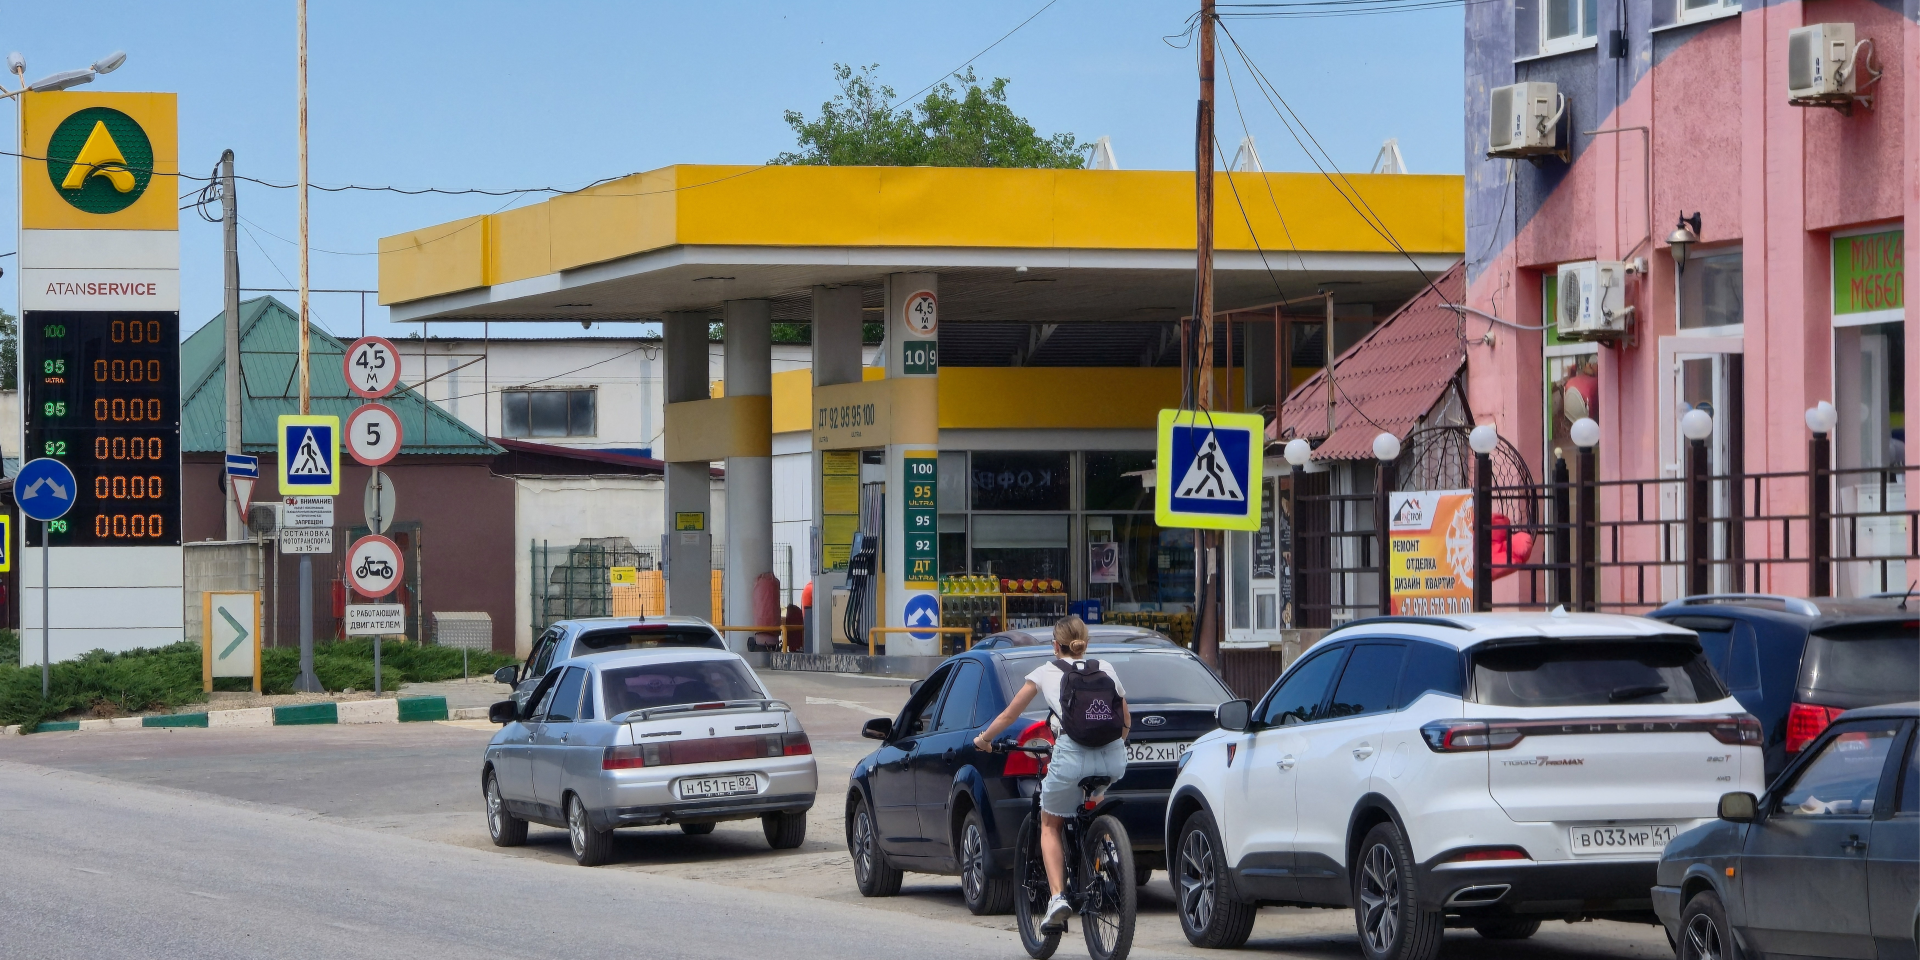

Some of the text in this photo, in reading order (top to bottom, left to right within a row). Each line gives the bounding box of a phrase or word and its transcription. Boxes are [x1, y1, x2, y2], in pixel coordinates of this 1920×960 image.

[46, 283, 157, 296] ATANSERVICE
[915, 302, 934, 316] 4,5
[44, 325, 66, 338] 100
[356, 350, 386, 372] 4,5
[905, 349, 936, 366] 10 9
[44, 360, 65, 373] 95
[366, 373, 378, 384] М
[44, 403, 65, 416] 95
[819, 403, 875, 430] ДТ 92 95 95 100
[366, 422, 381, 446] 5
[45, 441, 66, 455] 92
[911, 463, 933, 474] 100
[914, 485, 931, 498] 95
[47, 521, 67, 533] PG
[915, 516, 930, 526] 95
[915, 540, 930, 551] 92
[1392, 540, 1420, 552] РЕМОНТ
[913, 560, 931, 573] ДТ
[1406, 558, 1437, 572] ОТДЕЛКА
[1394, 575, 1456, 592] ДИЗАЙН КВАРТИР
[357, 609, 400, 618] РАБОТАЮЩИМ
[350, 621, 401, 630] ДВИГАТЕЛЕМ
[1562, 722, 1678, 732] CHERY
